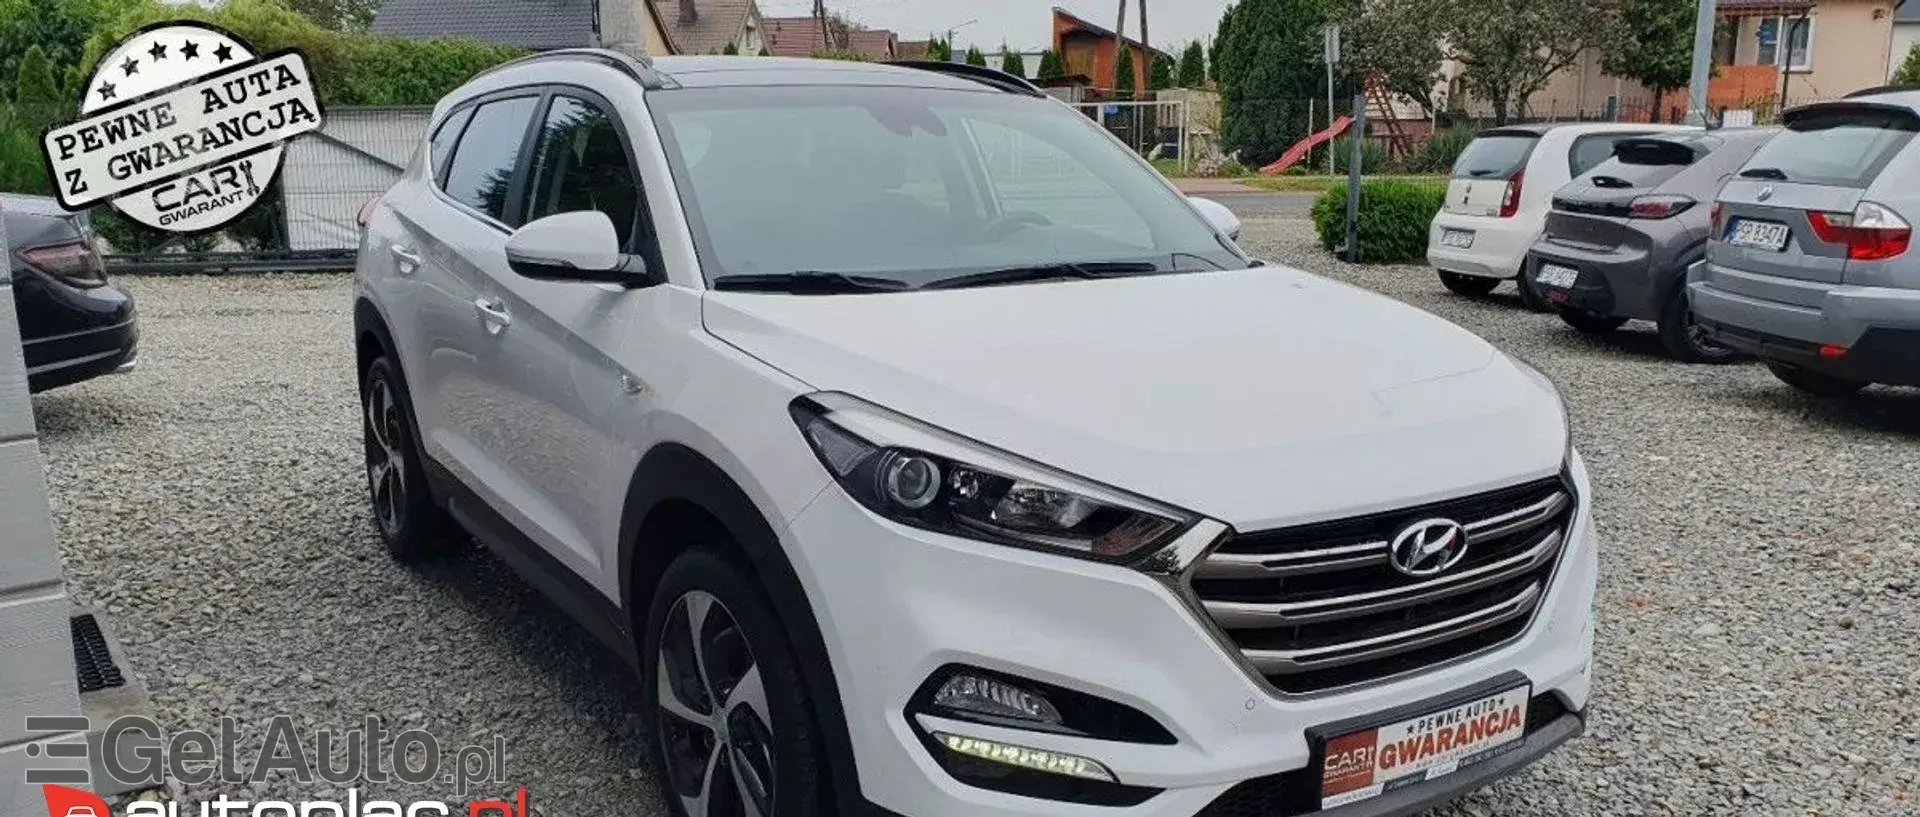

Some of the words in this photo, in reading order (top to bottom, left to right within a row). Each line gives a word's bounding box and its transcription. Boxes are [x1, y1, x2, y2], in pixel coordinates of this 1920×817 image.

[1379, 704, 1520, 770] GWARANCJA
[1418, 708, 1462, 733] PEWNE
[1466, 699, 1496, 719] AUTO
